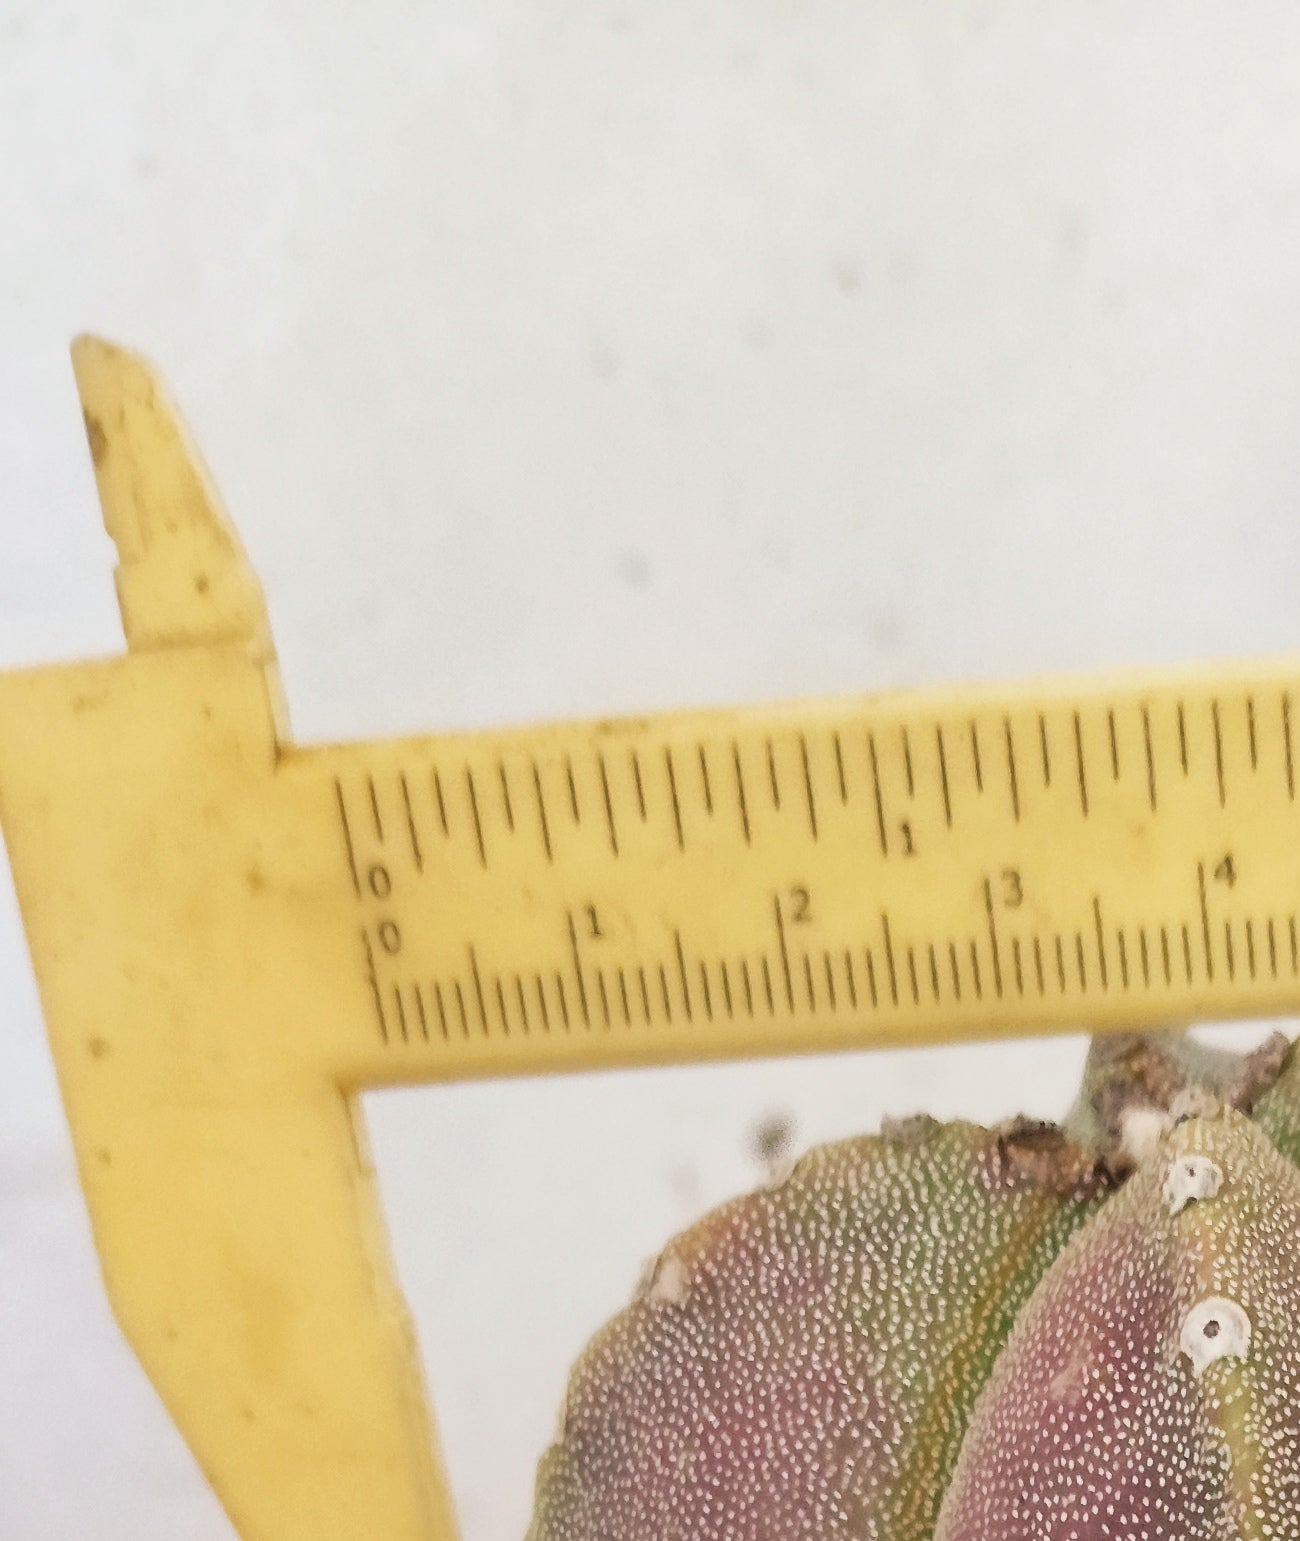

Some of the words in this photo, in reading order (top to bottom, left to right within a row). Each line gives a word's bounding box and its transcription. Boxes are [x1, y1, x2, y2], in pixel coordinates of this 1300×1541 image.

[368, 865, 392, 899] 0
[900, 820, 916, 857] 1
[378, 921, 401, 956] 0
[585, 903, 602, 938] 1
[792, 888, 813, 922] 2
[1002, 871, 1024, 906] 3
[1214, 852, 1237, 889] 4
